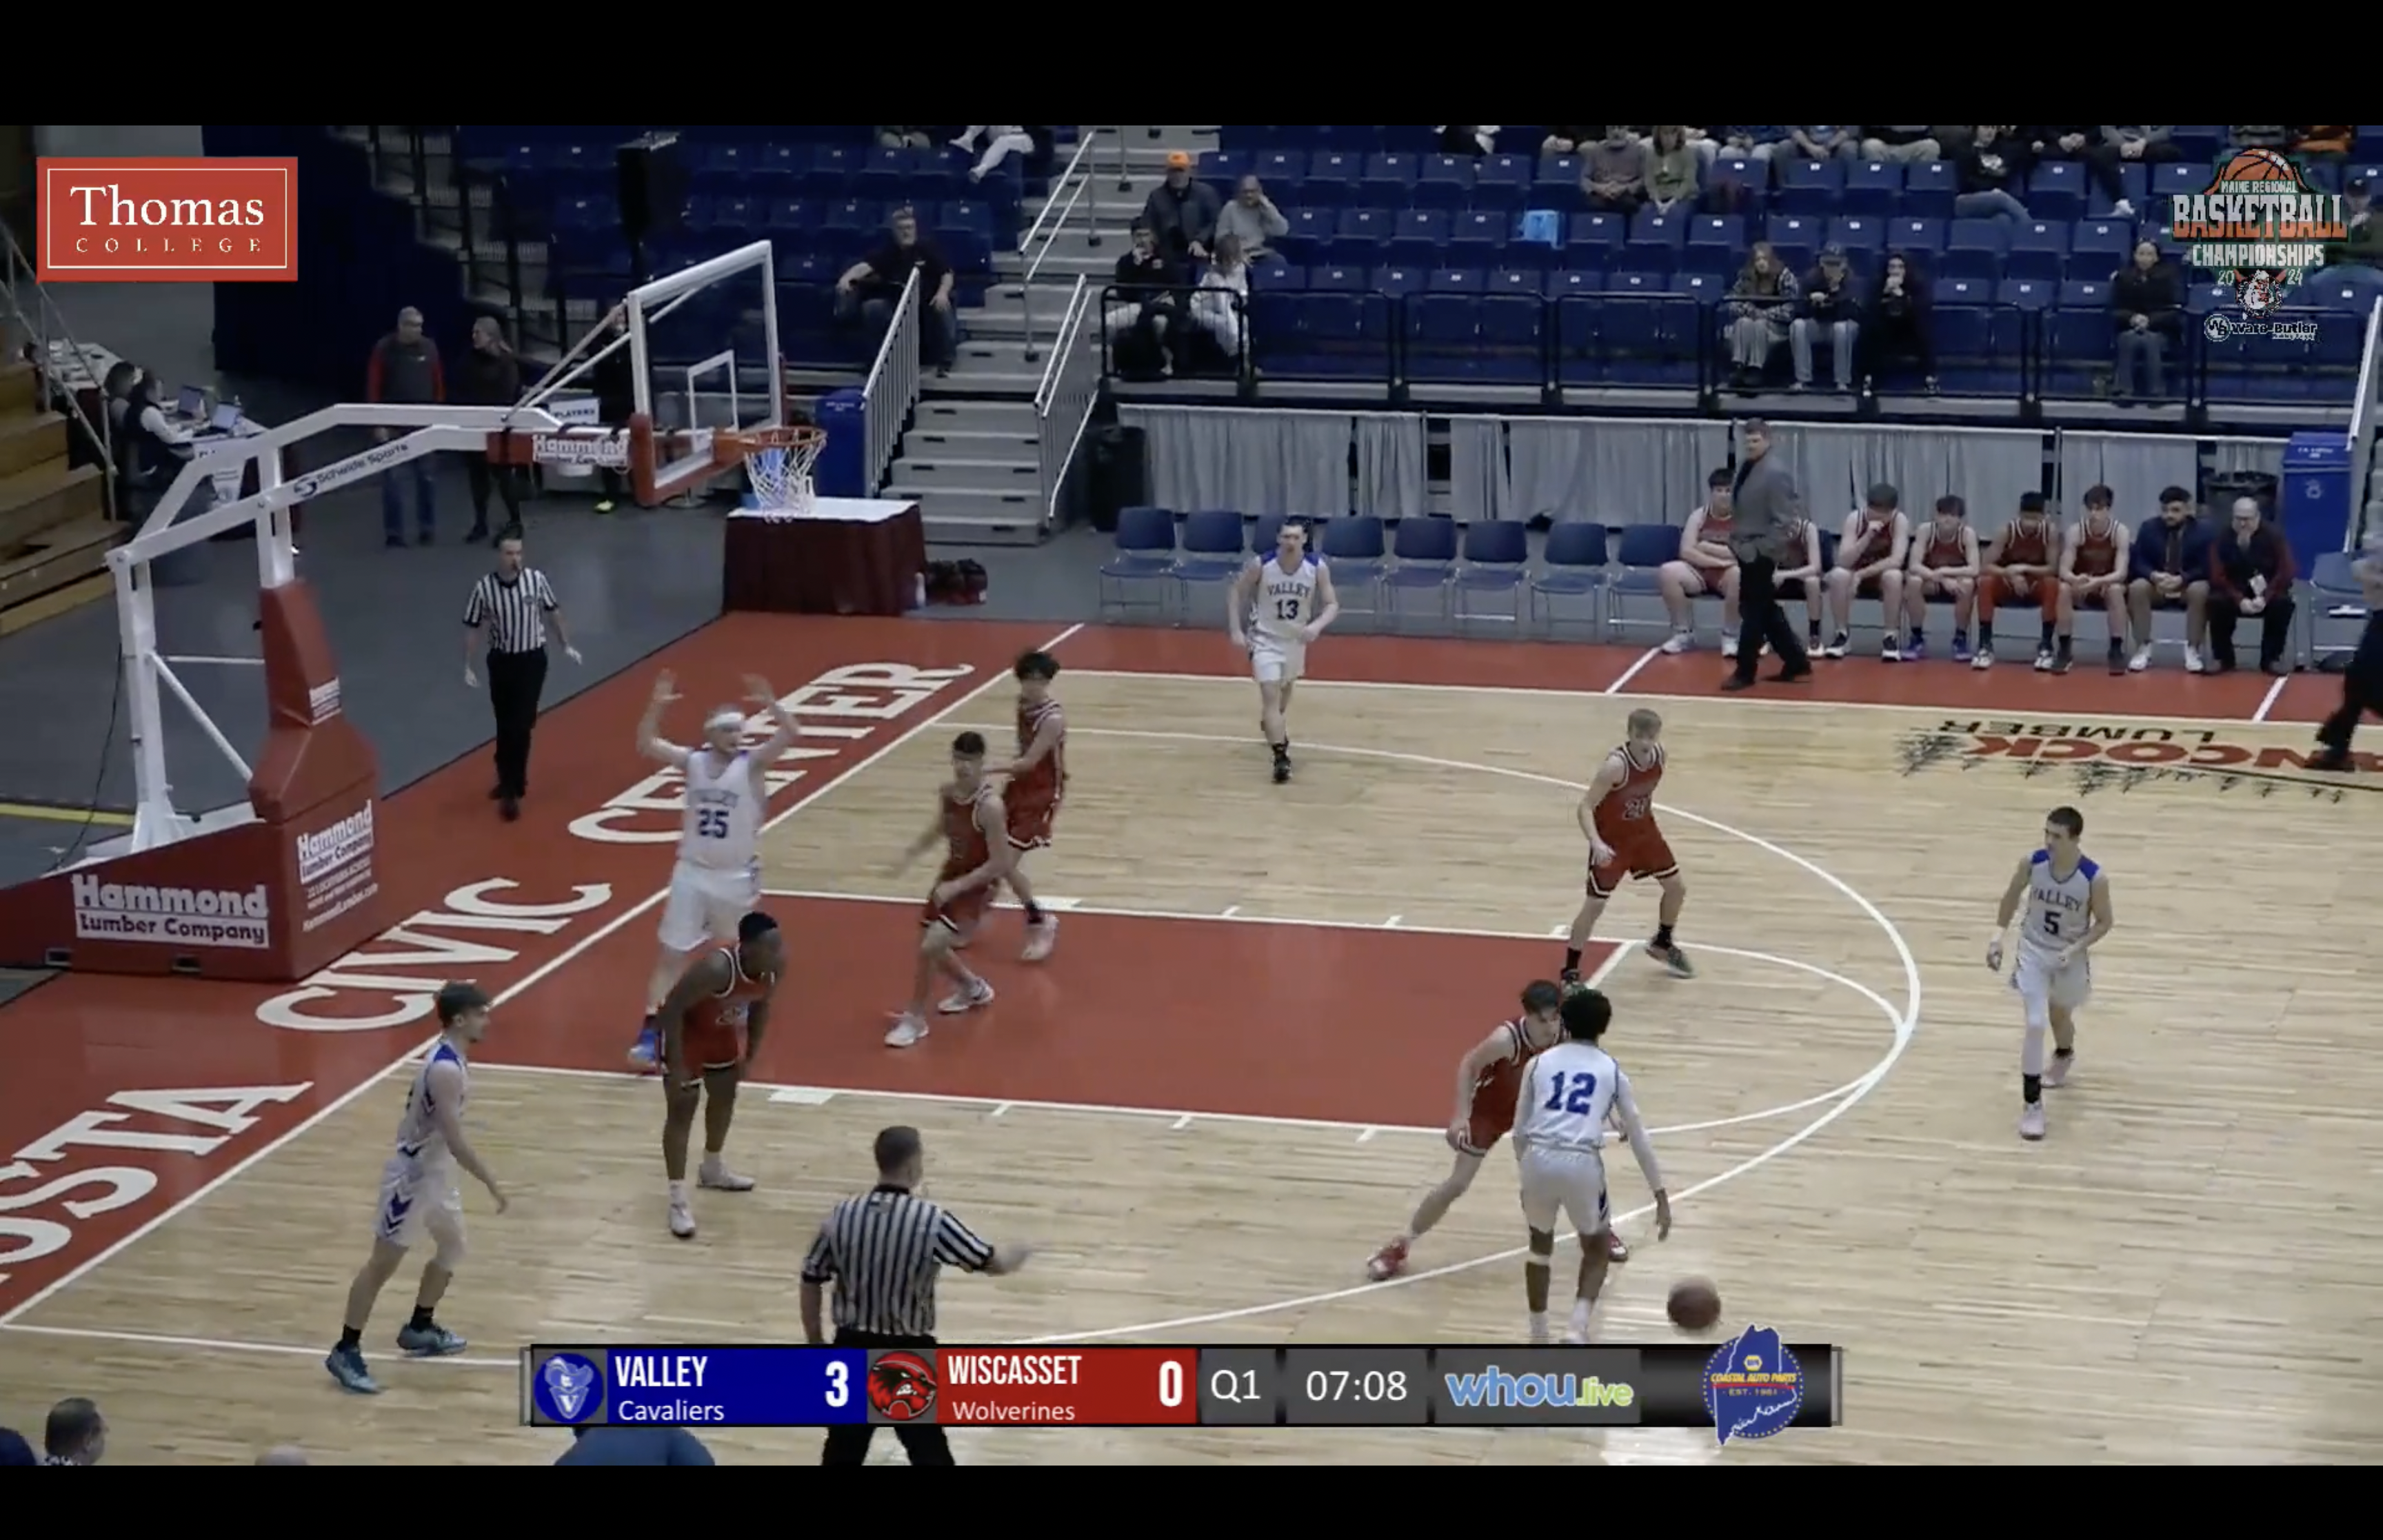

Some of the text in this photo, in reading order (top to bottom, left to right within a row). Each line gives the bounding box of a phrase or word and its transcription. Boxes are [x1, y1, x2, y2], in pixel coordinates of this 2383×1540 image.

[1268, 581, 1310, 598] VALLEY
[1276, 598, 1299, 620] 13
[1938, 720, 2215, 743] LUMBER
[698, 809, 729, 839] 25
[72, 873, 269, 918] Hammond
[2031, 886, 2083, 913] VALLEY
[79, 913, 265, 945] Lumber Company
[2043, 911, 2062, 935] 5
[256, 877, 612, 1031] CIVIC
[1544, 1071, 1597, 1116] 12
